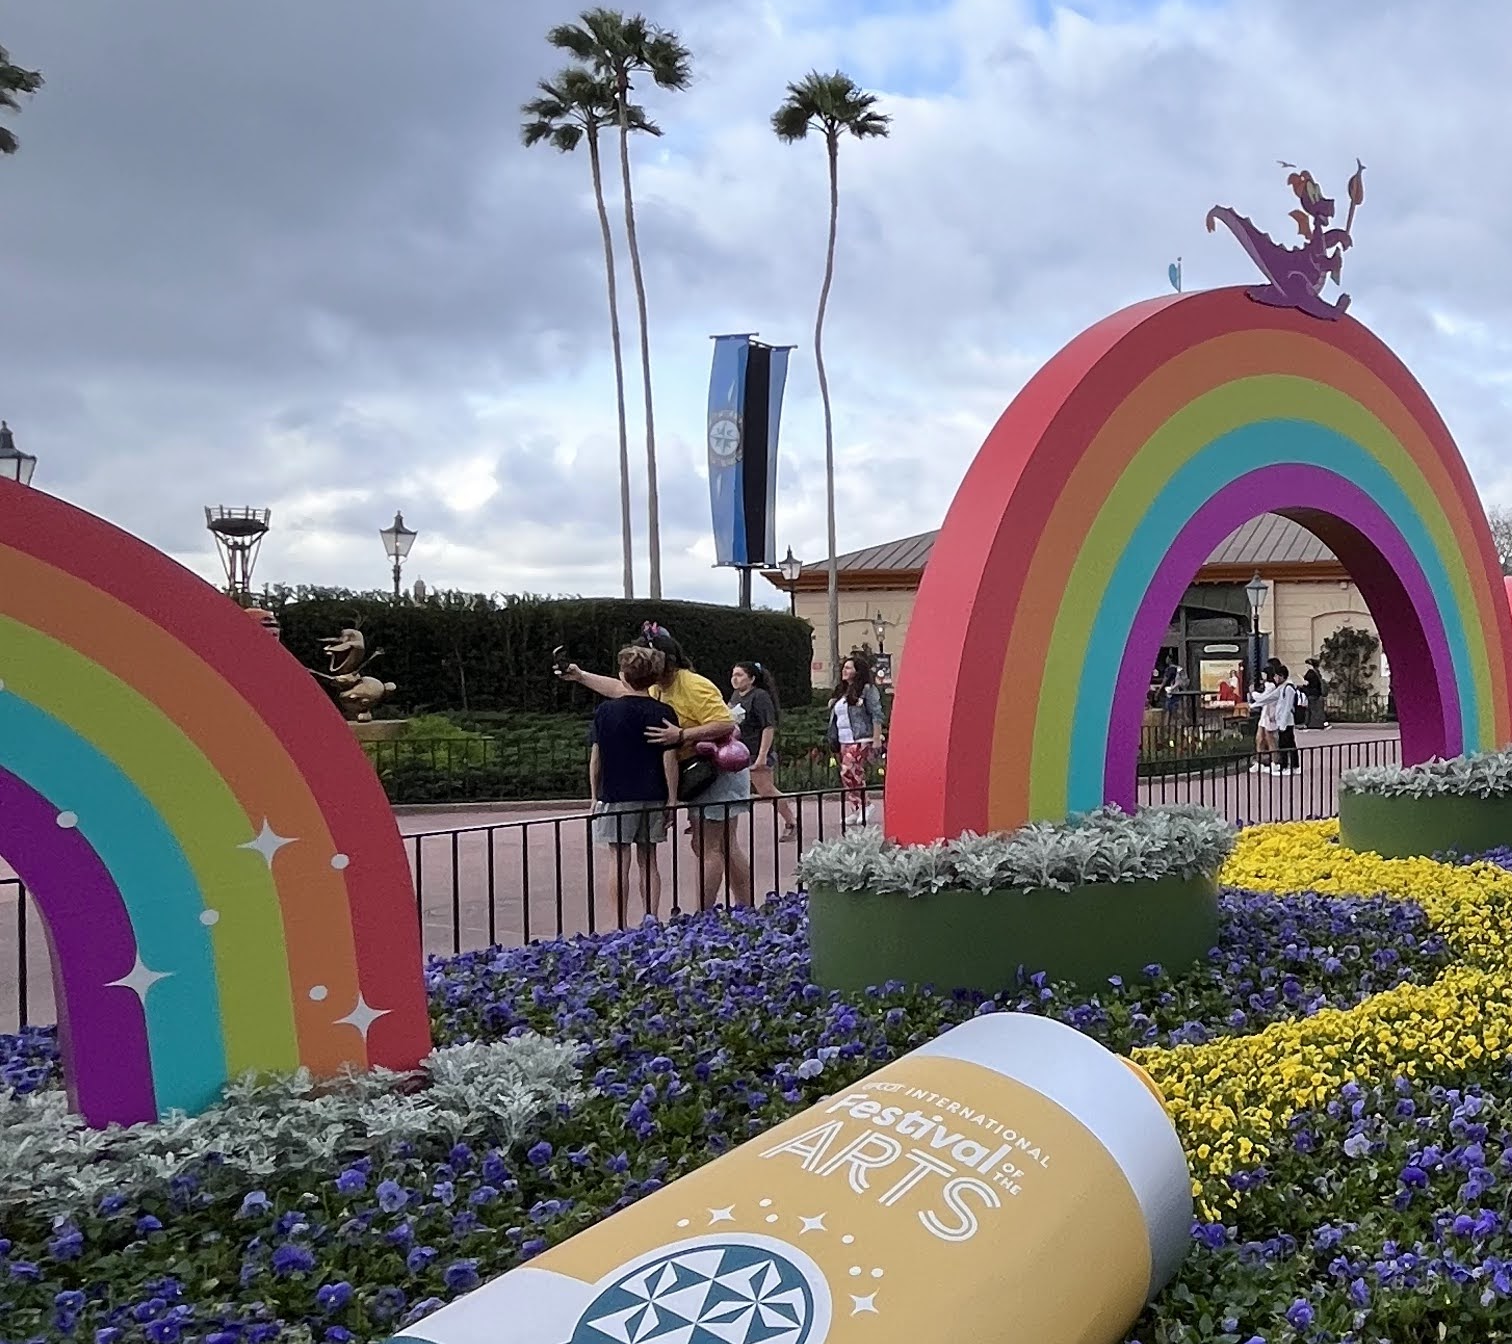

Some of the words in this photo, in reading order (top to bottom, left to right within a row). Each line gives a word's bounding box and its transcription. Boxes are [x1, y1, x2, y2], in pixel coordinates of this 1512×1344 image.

[825, 1093, 1012, 1175] Festival
[904, 1087, 1051, 1169] INTERNATIONAL
[758, 1119, 1001, 1242] ARTS
[993, 1171, 1022, 1196] THE
[1002, 1162, 1025, 1178] OF
